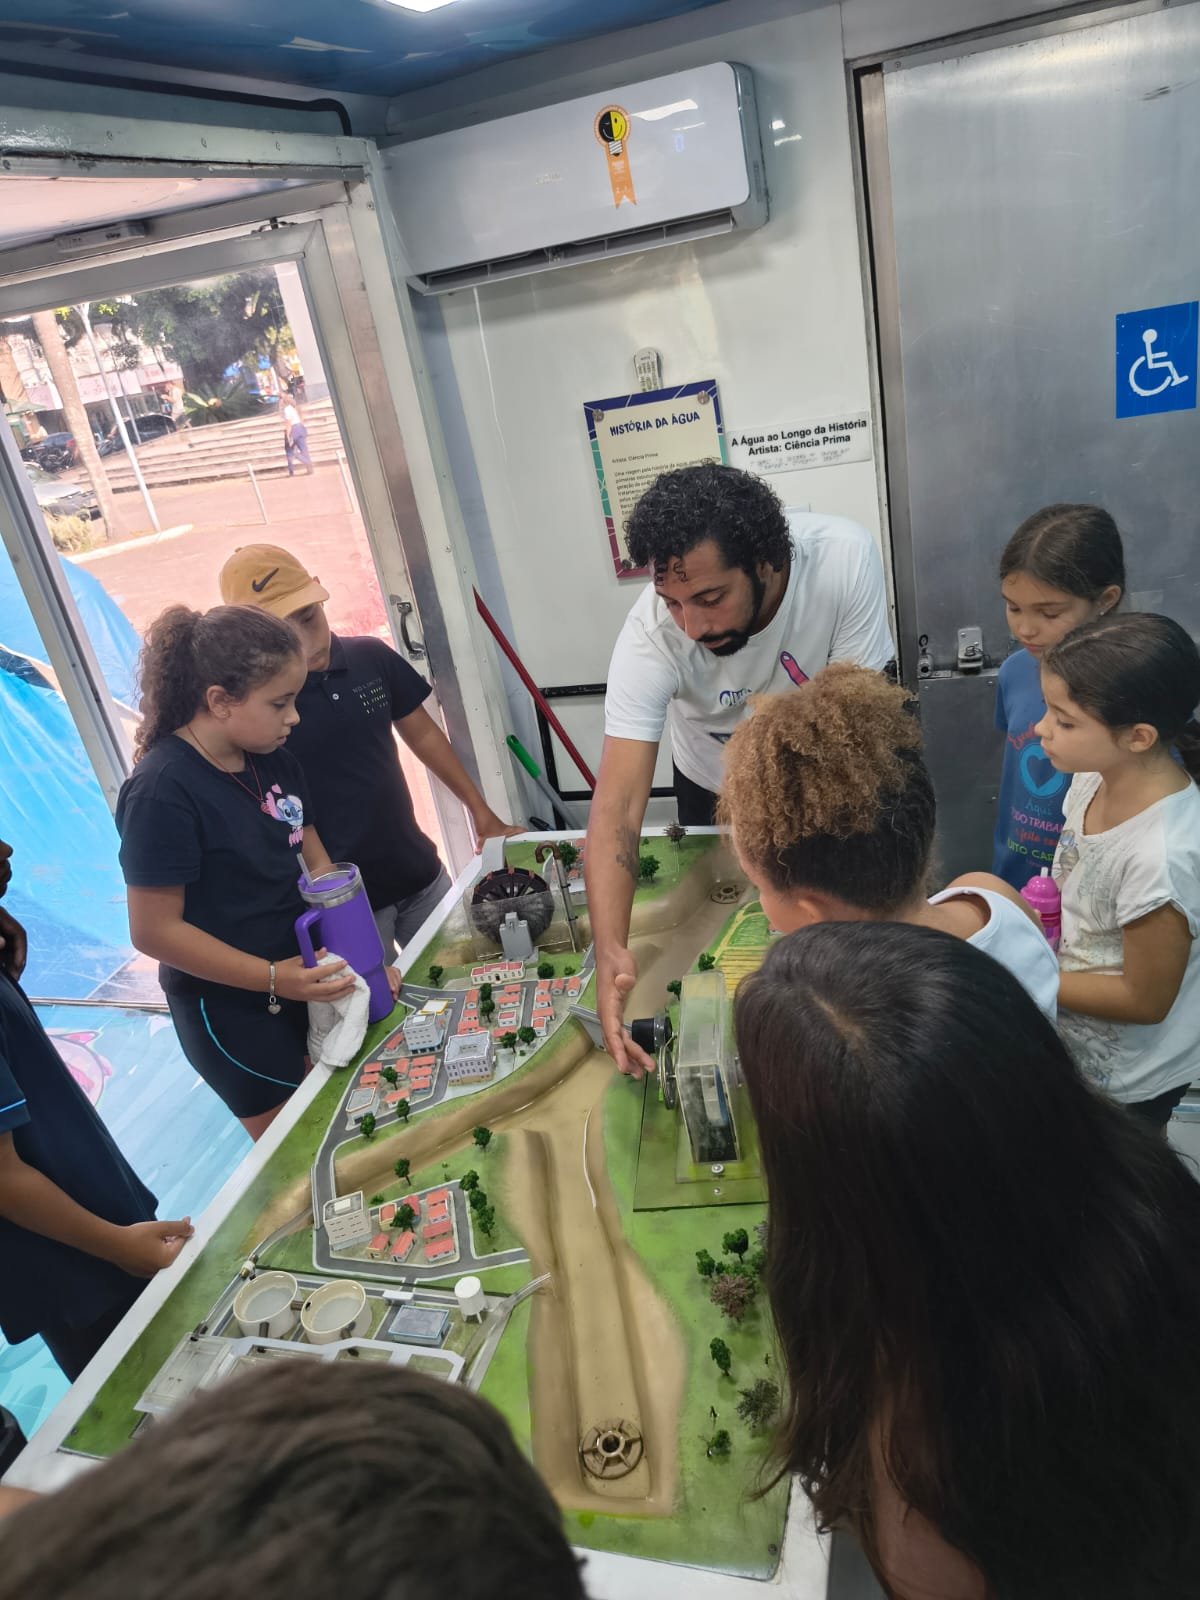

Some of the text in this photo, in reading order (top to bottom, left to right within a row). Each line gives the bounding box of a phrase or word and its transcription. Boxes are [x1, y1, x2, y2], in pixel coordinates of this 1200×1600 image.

[609, 411, 700, 436] HISTÓRIA DA ÁGUA
[731, 418, 867, 447] A Água ao Longo da História
[748, 434, 851, 456] Artista: Ciência Prima
